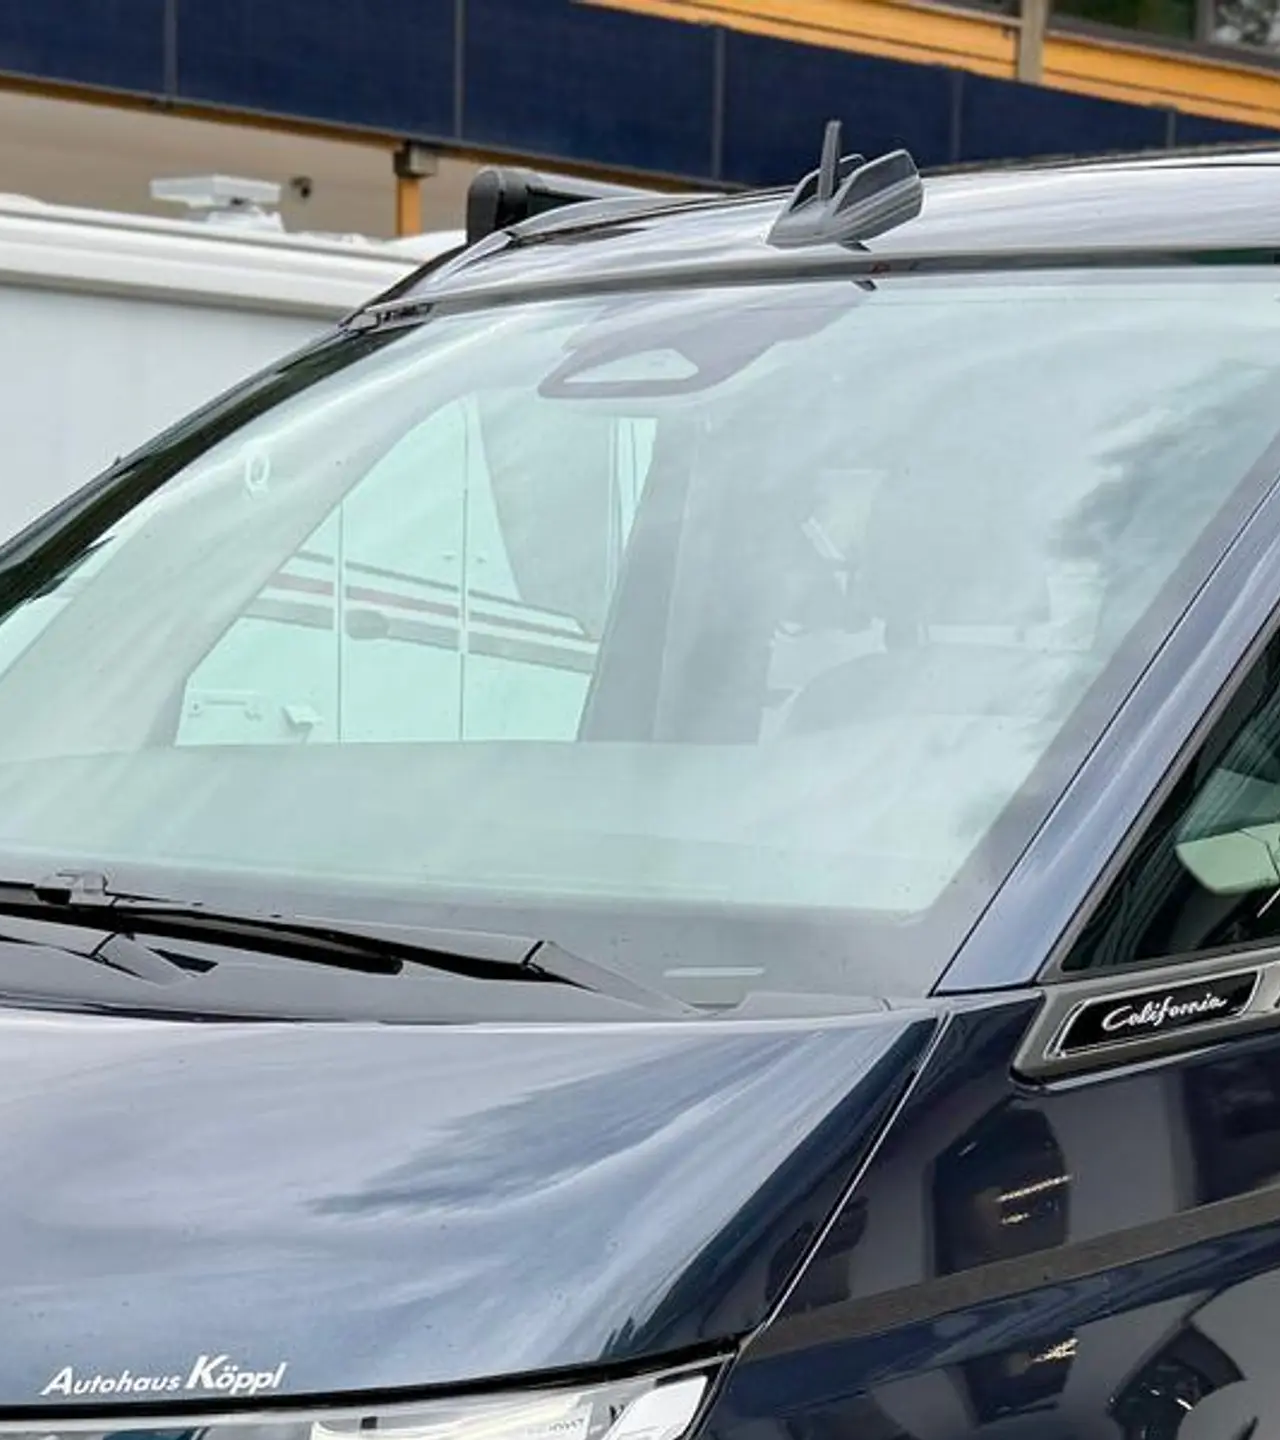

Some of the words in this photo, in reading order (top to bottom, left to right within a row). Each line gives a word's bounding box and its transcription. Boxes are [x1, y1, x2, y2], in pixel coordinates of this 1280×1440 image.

[1102, 992, 1228, 1031] California
[40, 1366, 181, 1396] Autohaus
[184, 1354, 288, 1395] Köppl
